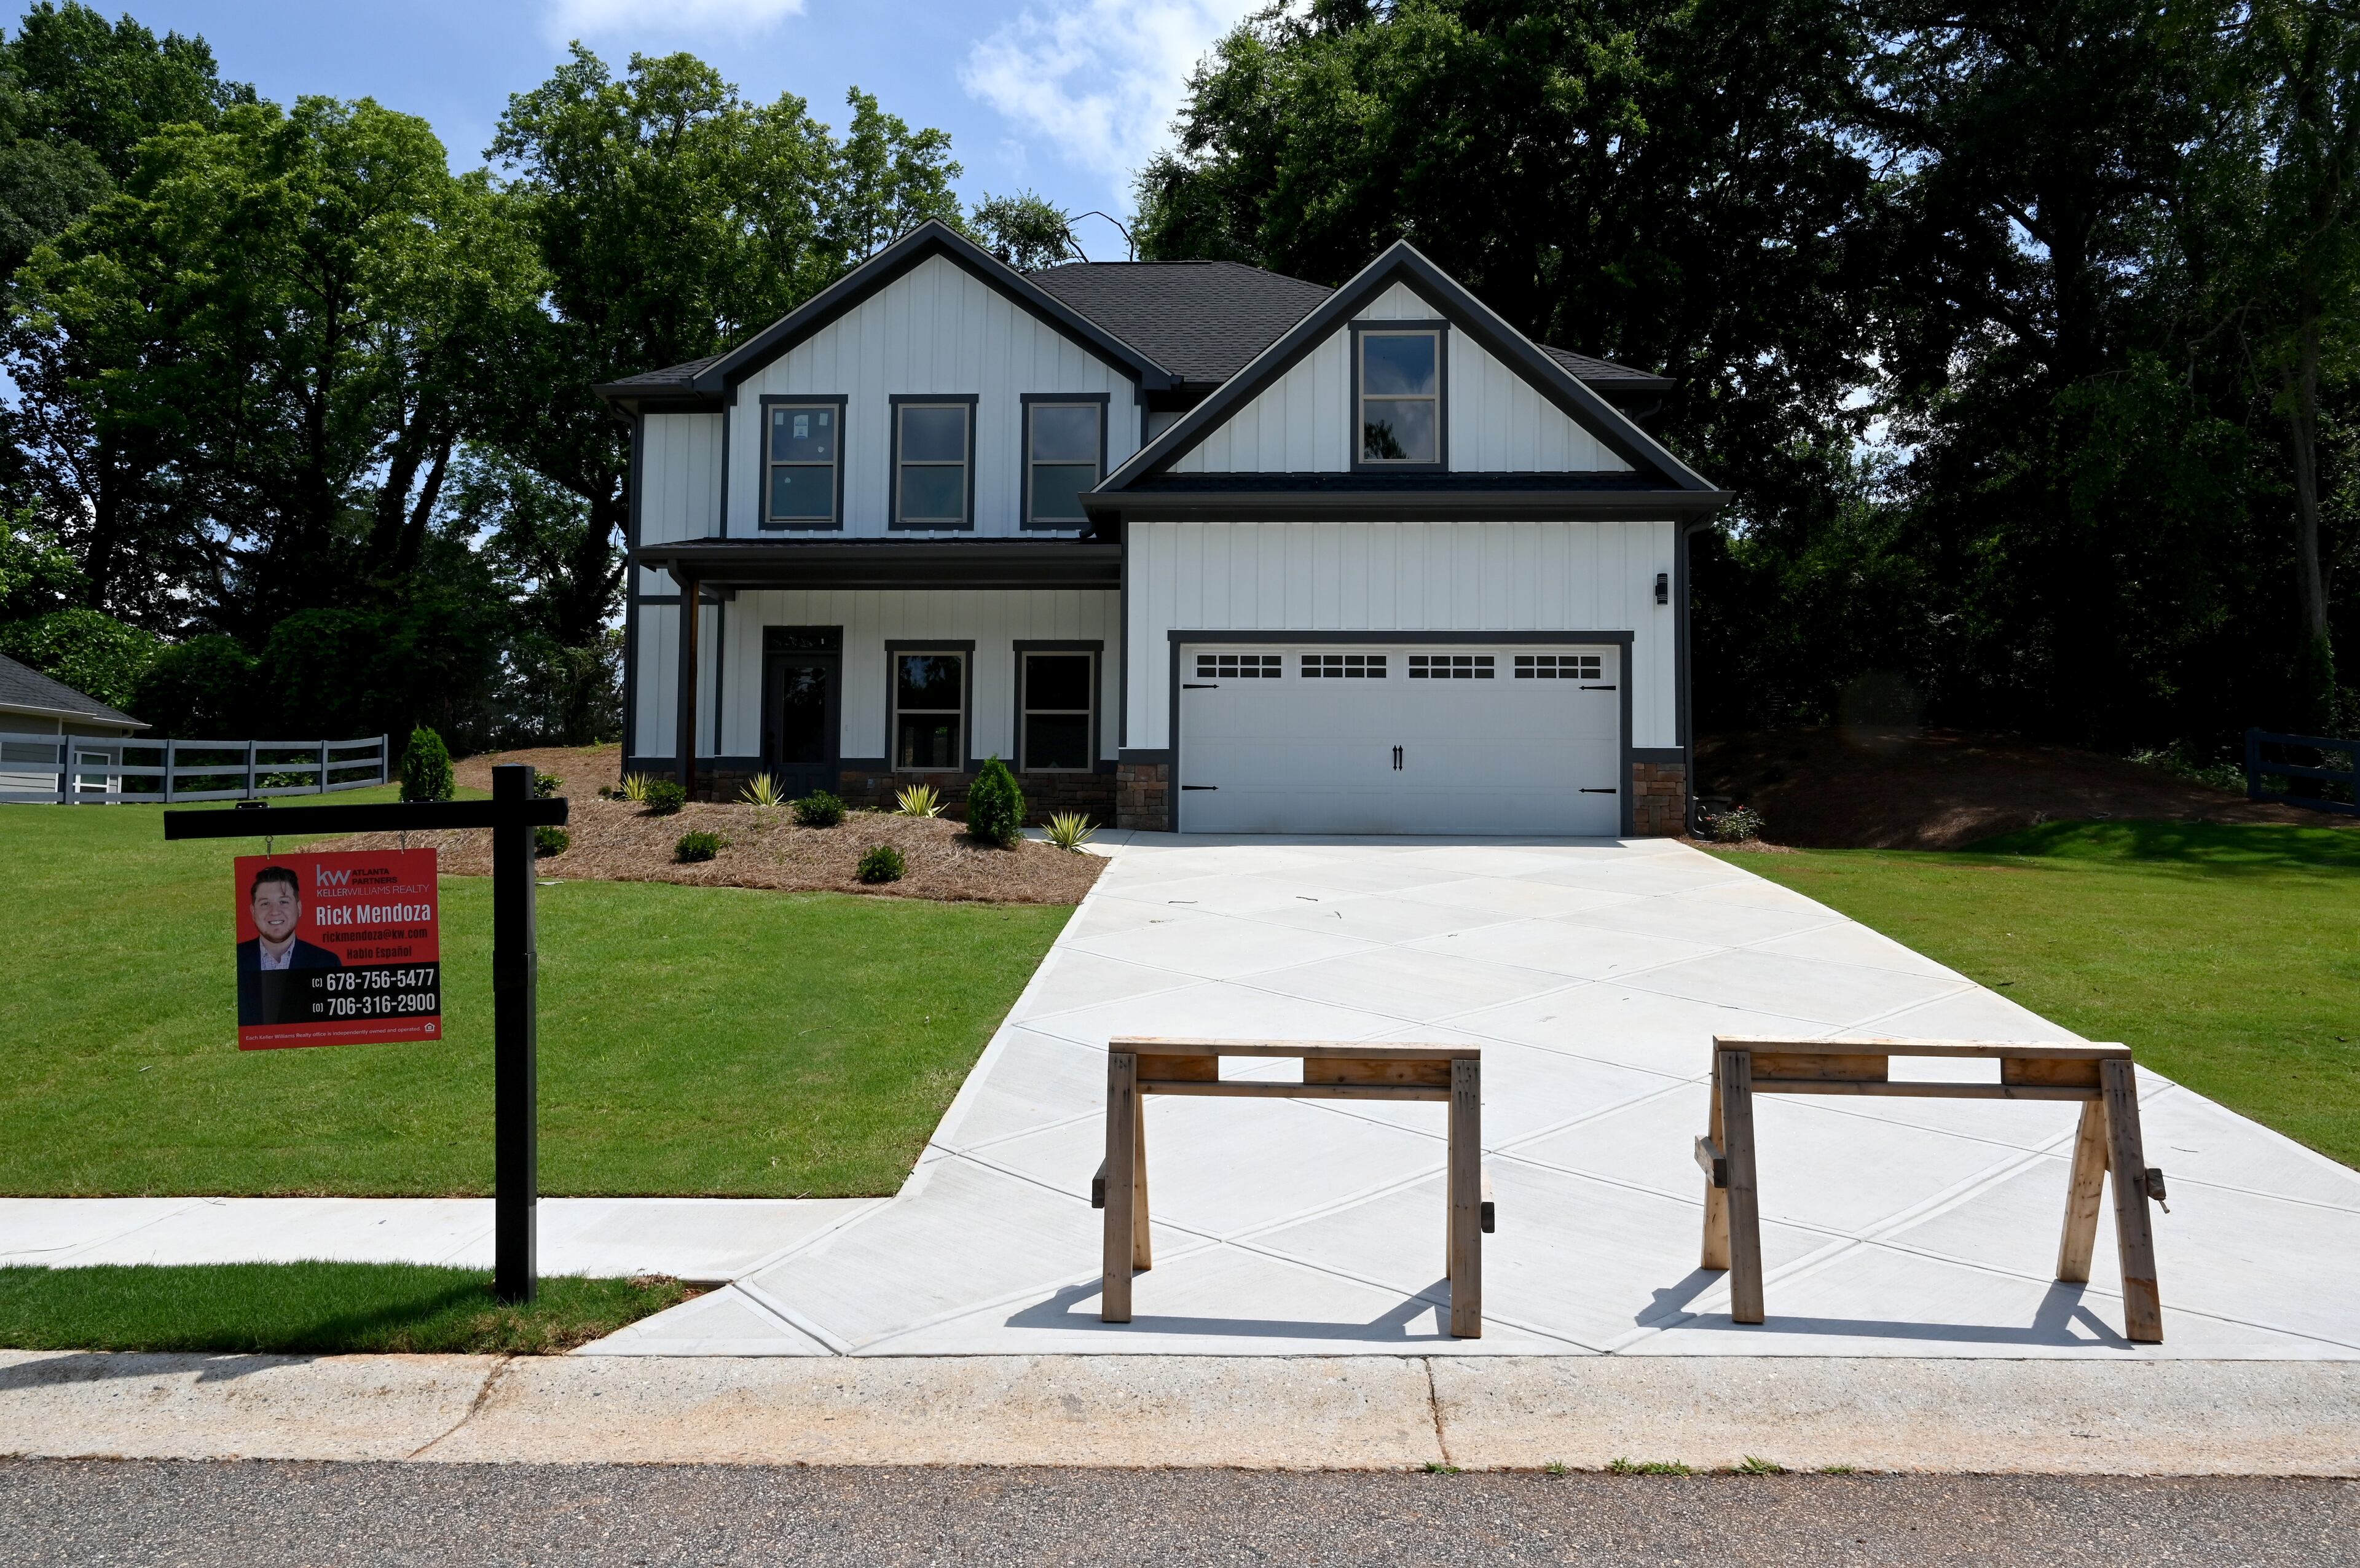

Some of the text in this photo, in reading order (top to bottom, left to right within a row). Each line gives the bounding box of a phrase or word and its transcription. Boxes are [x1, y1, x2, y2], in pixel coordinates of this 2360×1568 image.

[316, 864, 352, 887] kw
[393, 884, 430, 894] REALTY
[316, 903, 431, 925] Rick Mendoza
[322, 928, 428, 943] rickmendoza@kw.com
[347, 946, 412, 959] Hablo Español
[326, 968, 435, 991] 678-756-5477
[327, 993, 436, 1016] 706-316-2900
